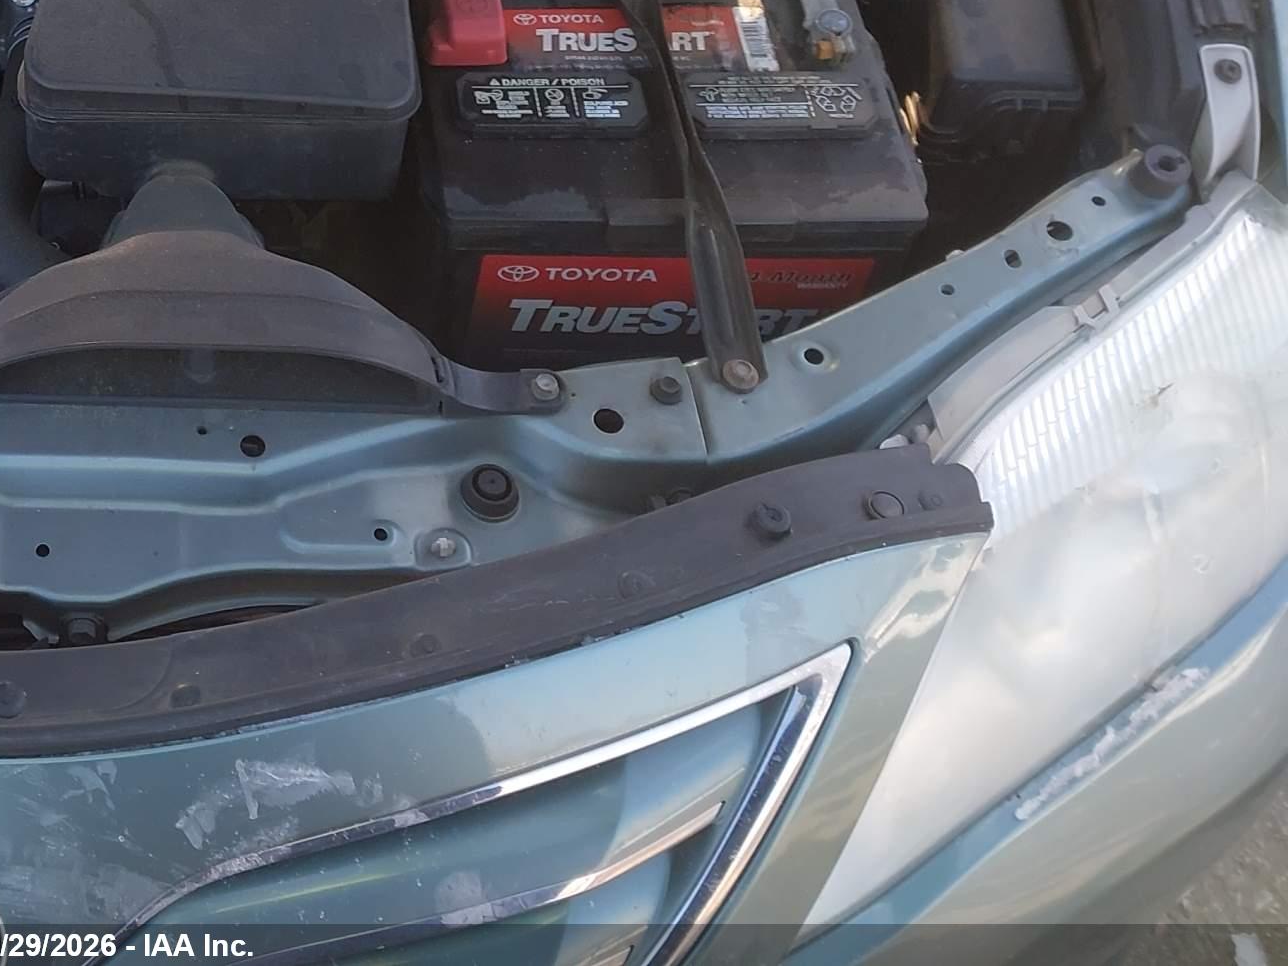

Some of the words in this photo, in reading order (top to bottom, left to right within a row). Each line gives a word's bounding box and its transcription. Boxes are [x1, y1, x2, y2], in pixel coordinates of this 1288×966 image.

[539, 14, 604, 24] TOYOTA
[501, 77, 550, 87] DANGER
[551, 77, 560, 87] /
[561, 77, 606, 87] POISON
[544, 267, 659, 283] TOYOTA
